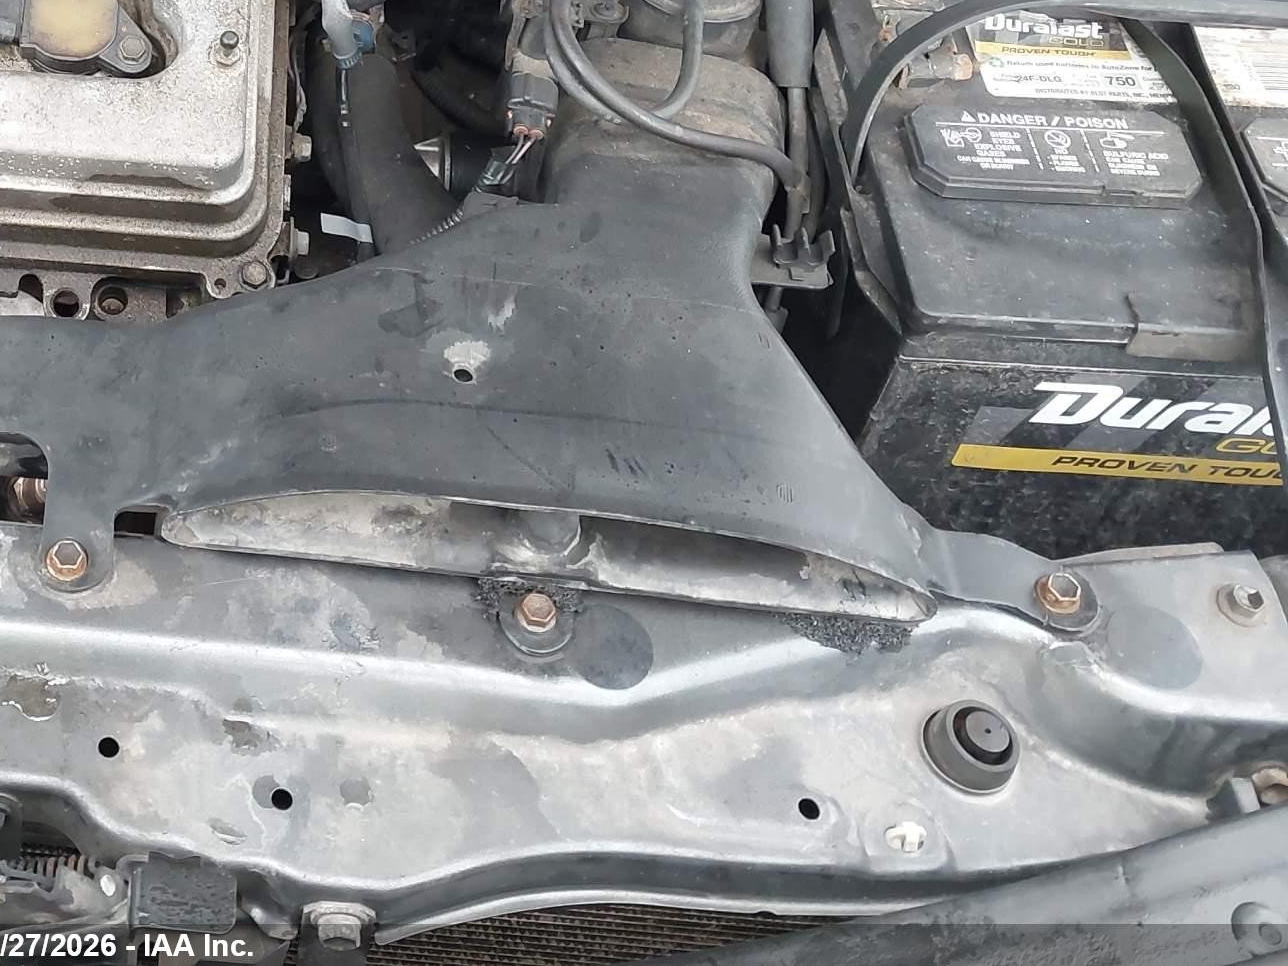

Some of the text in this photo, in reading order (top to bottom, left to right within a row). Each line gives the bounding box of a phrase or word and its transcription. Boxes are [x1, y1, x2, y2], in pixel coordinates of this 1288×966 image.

[984, 12, 1104, 40] Duralast
[1048, 36, 1105, 47] GOLD
[1001, 45, 1097, 57] PROVEN TOUGH
[1103, 75, 1136, 87] 750
[976, 112, 1048, 126] DANGER
[1064, 116, 1129, 130] POISON
[1052, 455, 1197, 473] PROVEN
